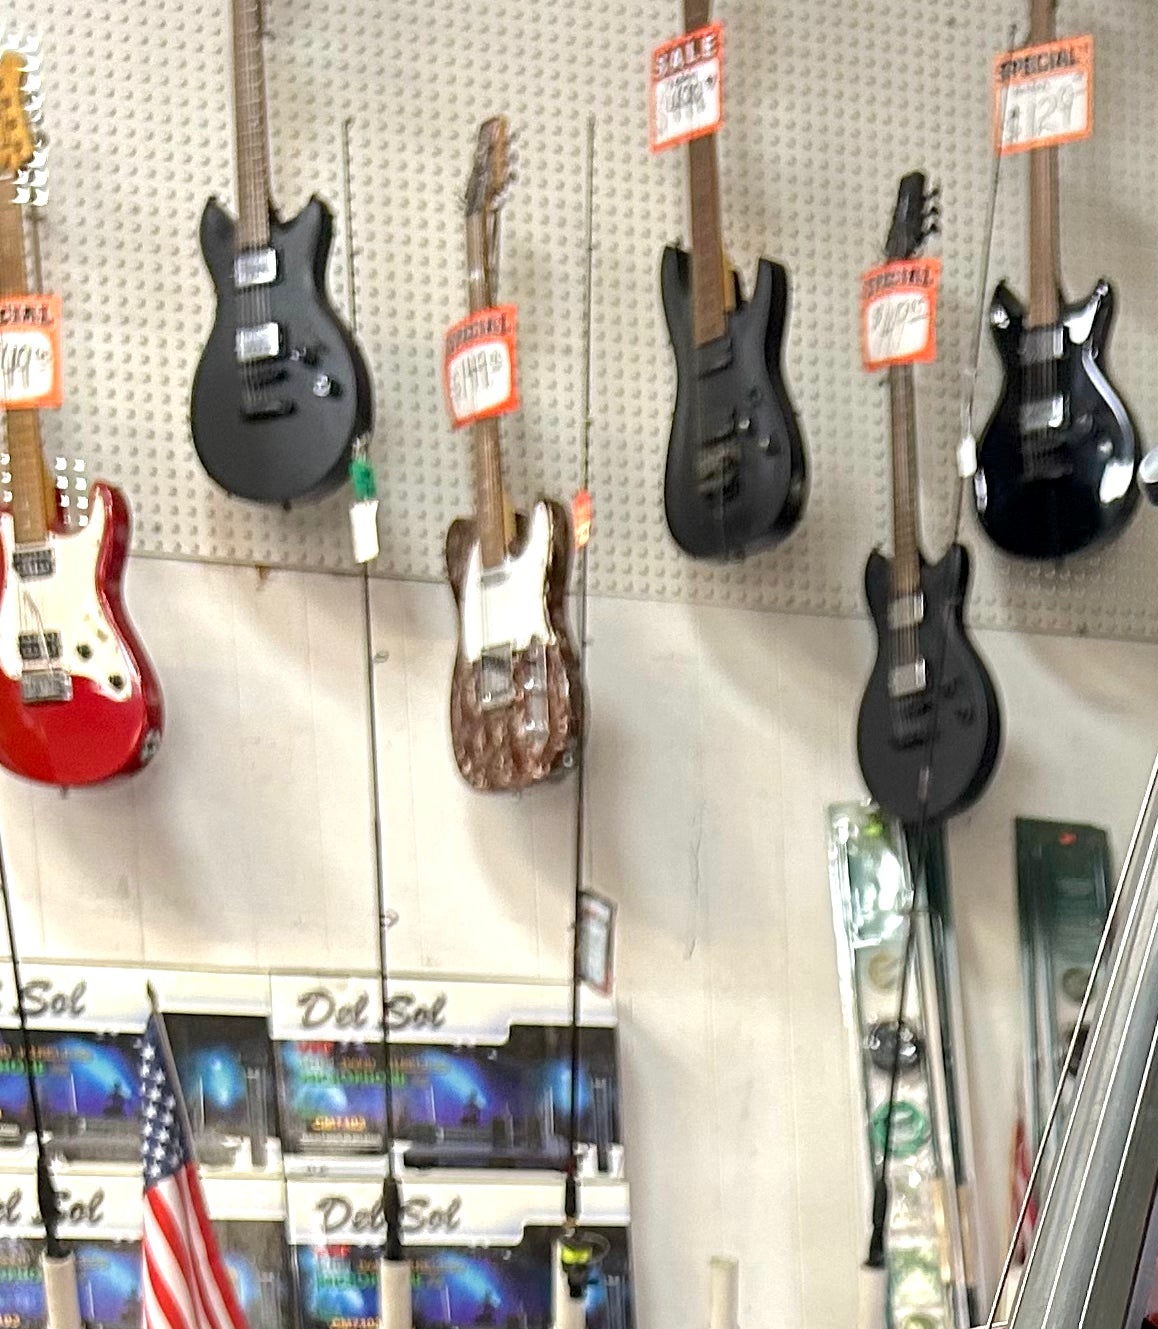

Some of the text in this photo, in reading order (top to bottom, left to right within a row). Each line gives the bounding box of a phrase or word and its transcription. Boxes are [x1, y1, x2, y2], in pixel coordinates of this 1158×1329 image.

[656, 35, 718, 75] SALE
[1000, 48, 1075, 80] SPECIAL
[864, 267, 933, 297] SPECIAL
[12, 980, 87, 1017] Sol
[297, 986, 448, 1032] Del Sol
[315, 1193, 463, 1235] Del Sol
